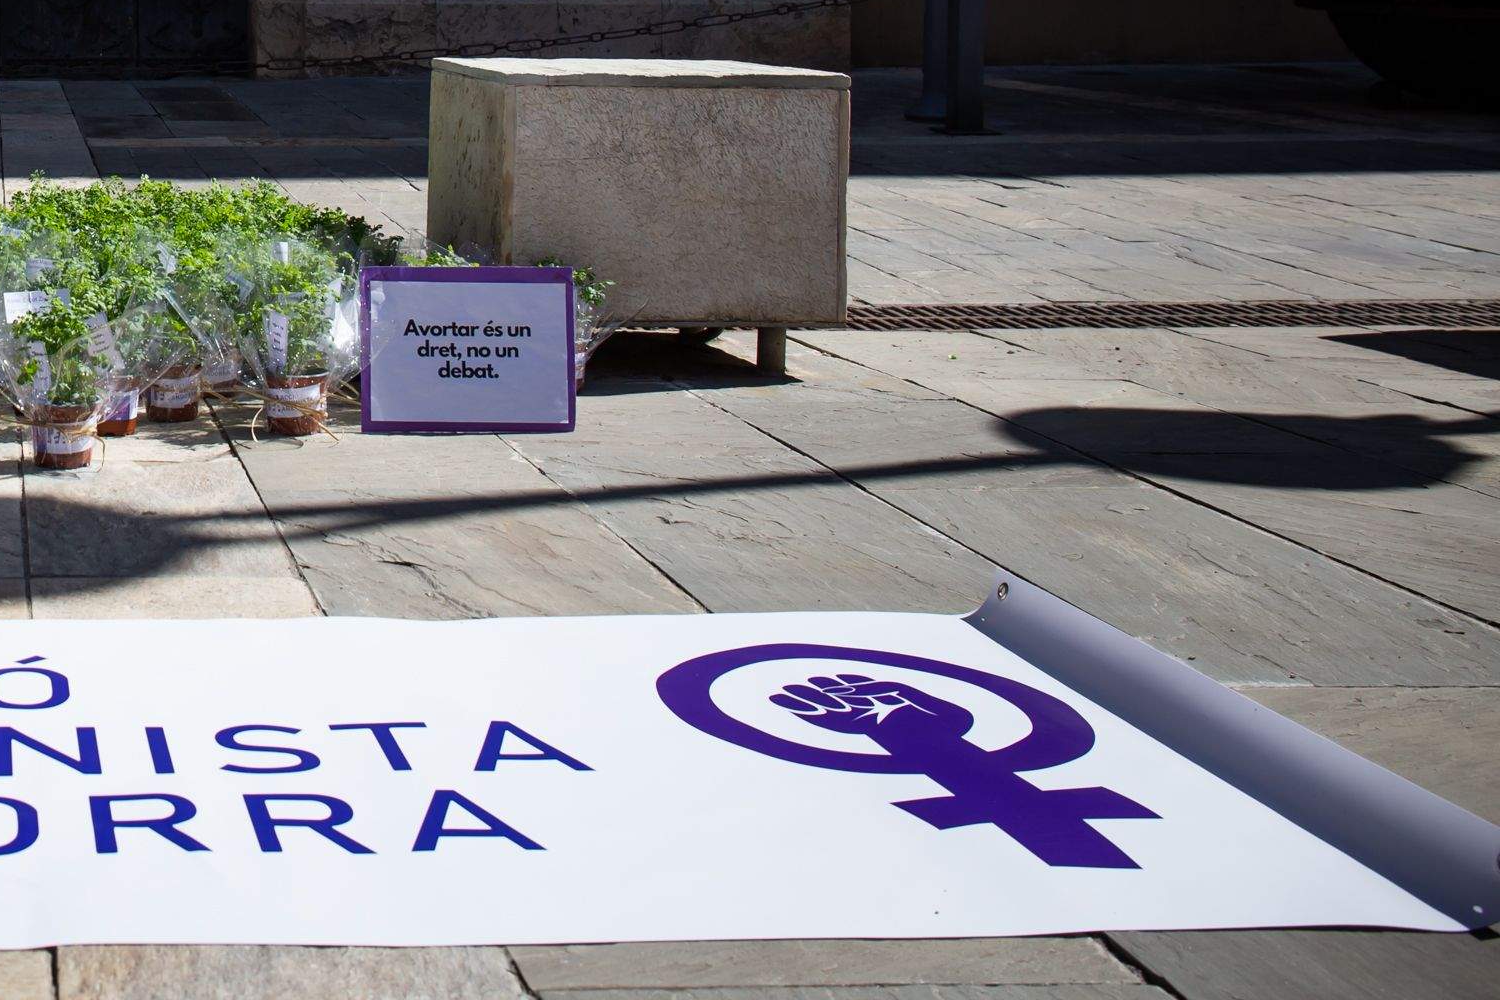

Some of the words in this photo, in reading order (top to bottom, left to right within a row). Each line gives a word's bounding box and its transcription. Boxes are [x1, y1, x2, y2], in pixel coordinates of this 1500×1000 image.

[403, 319, 479, 337] Avortar
[483, 320, 502, 337] és
[507, 324, 531, 337] un
[417, 340, 462, 360] dret,
[467, 345, 491, 358] no
[496, 345, 519, 358] un
[438, 361, 500, 379] debat.
